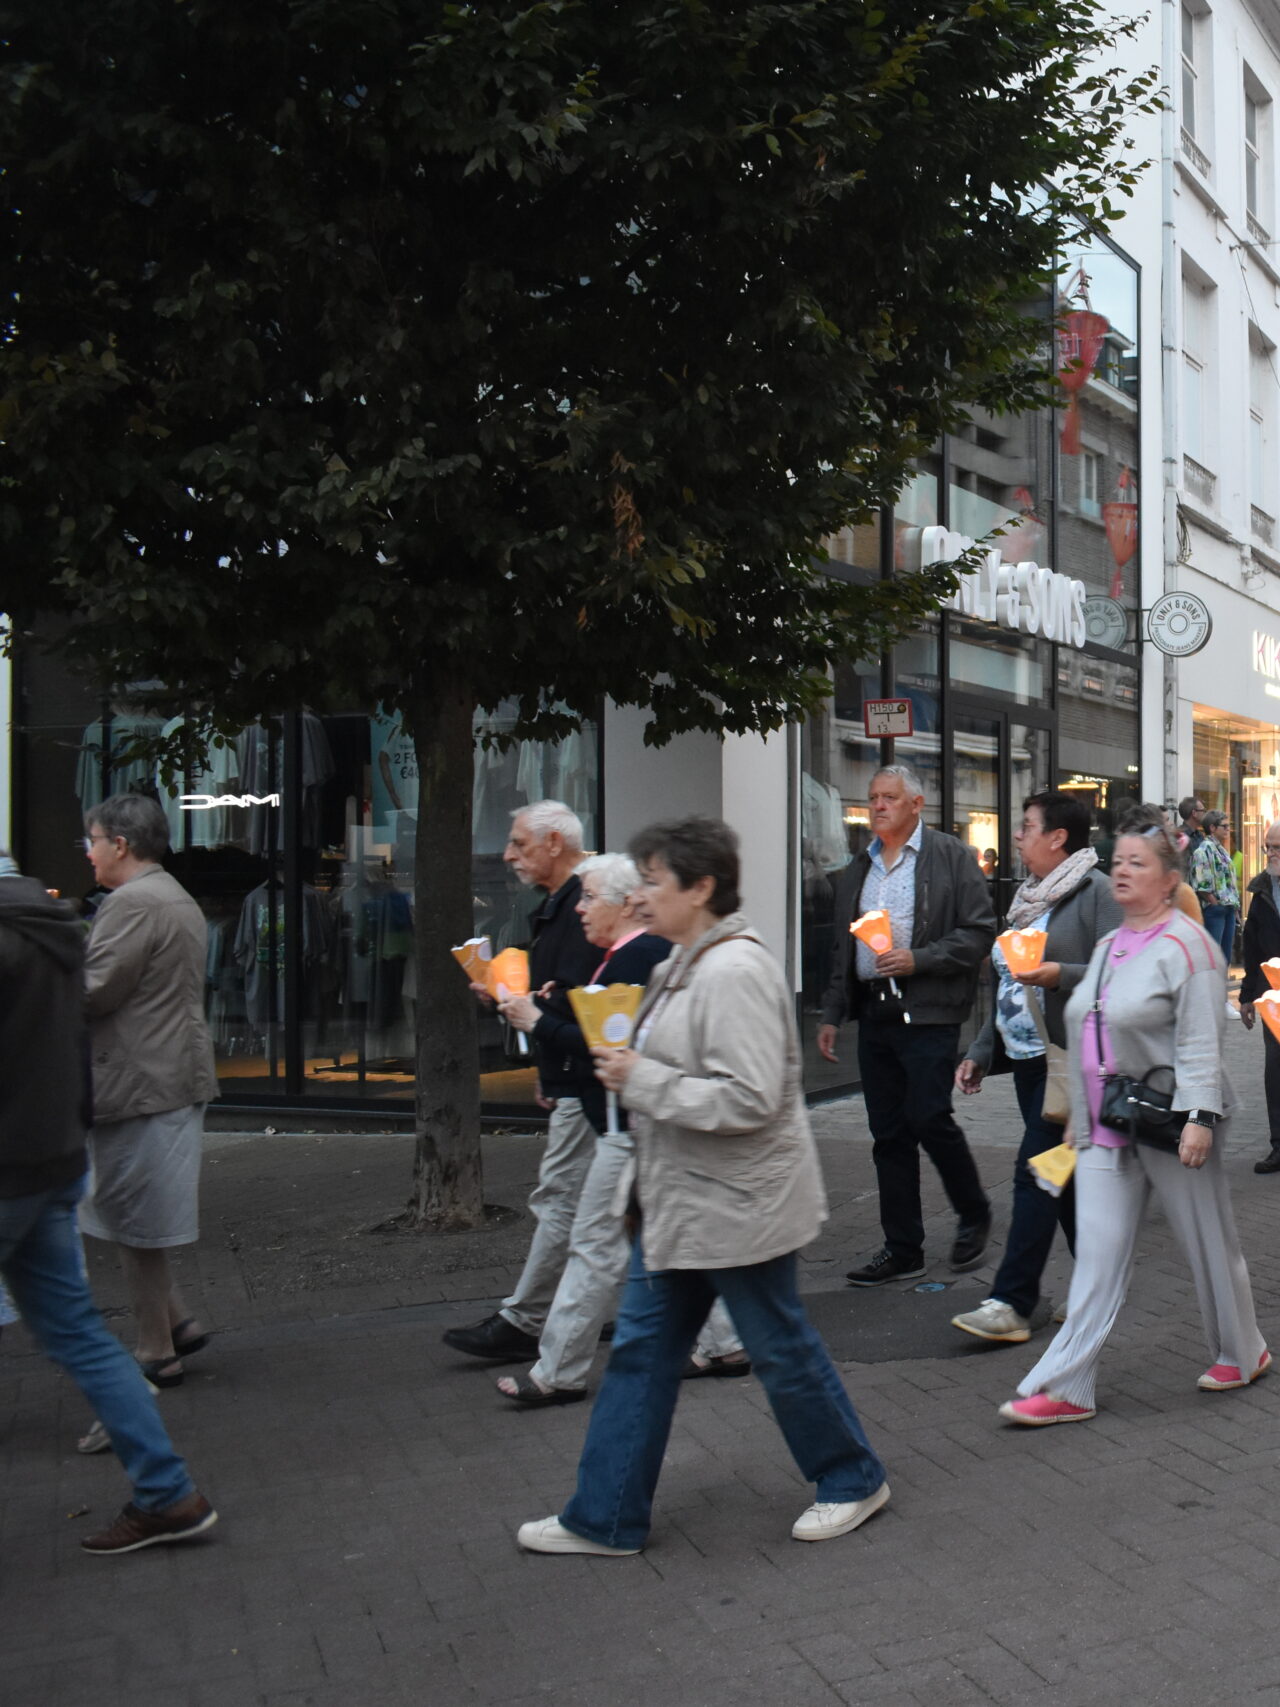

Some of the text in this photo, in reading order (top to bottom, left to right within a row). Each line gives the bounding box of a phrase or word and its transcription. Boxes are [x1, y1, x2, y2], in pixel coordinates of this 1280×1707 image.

[996, 565, 1020, 629] &
[1017, 561, 1086, 648] SONS
[1157, 599, 1201, 621] ONLY & SONS
[394, 753, 401, 765] 2
